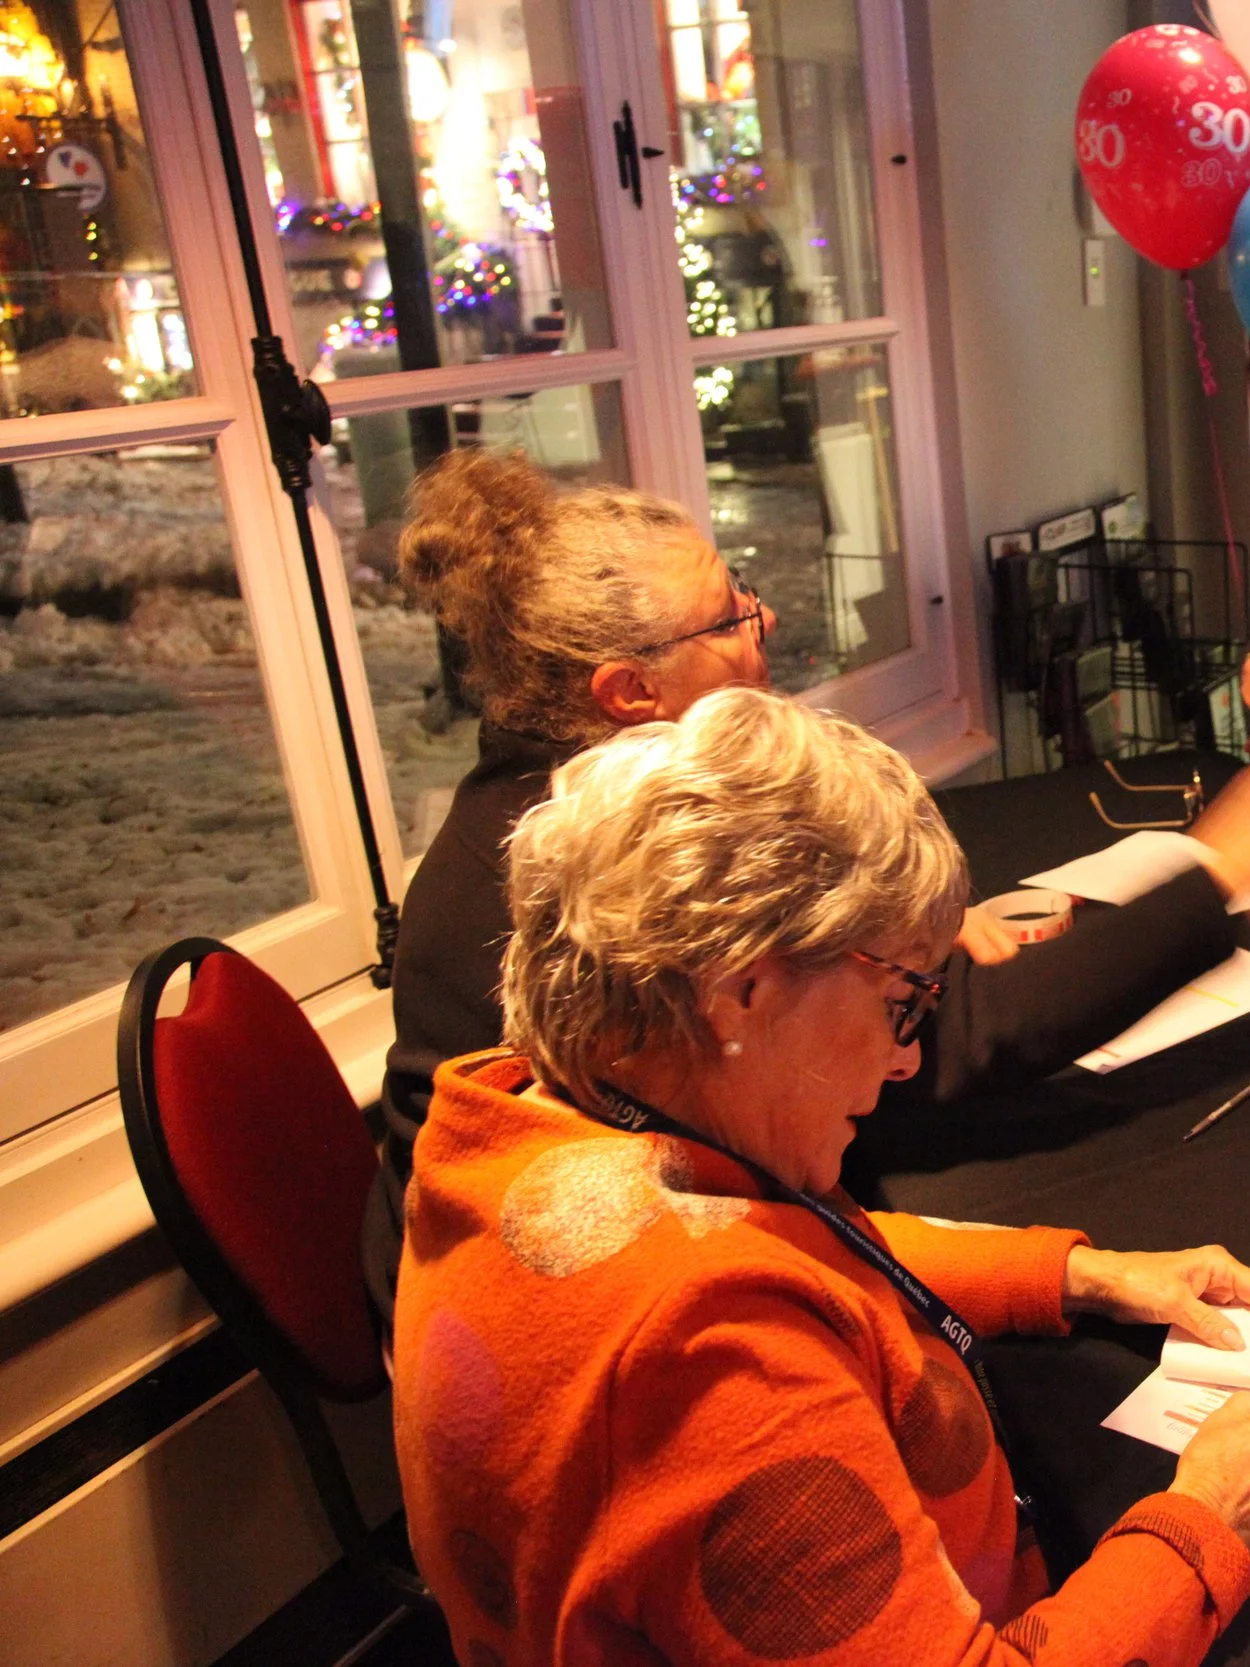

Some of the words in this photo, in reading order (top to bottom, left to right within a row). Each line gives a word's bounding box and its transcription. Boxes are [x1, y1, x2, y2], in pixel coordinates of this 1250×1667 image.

[1107, 88, 1132, 108] 30
[1079, 120, 1126, 168] 30
[1188, 101, 1250, 154] 30
[1181, 157, 1223, 188] 30
[903, 1275, 931, 1308] Québec
[941, 1314, 972, 1356] AGTQ
